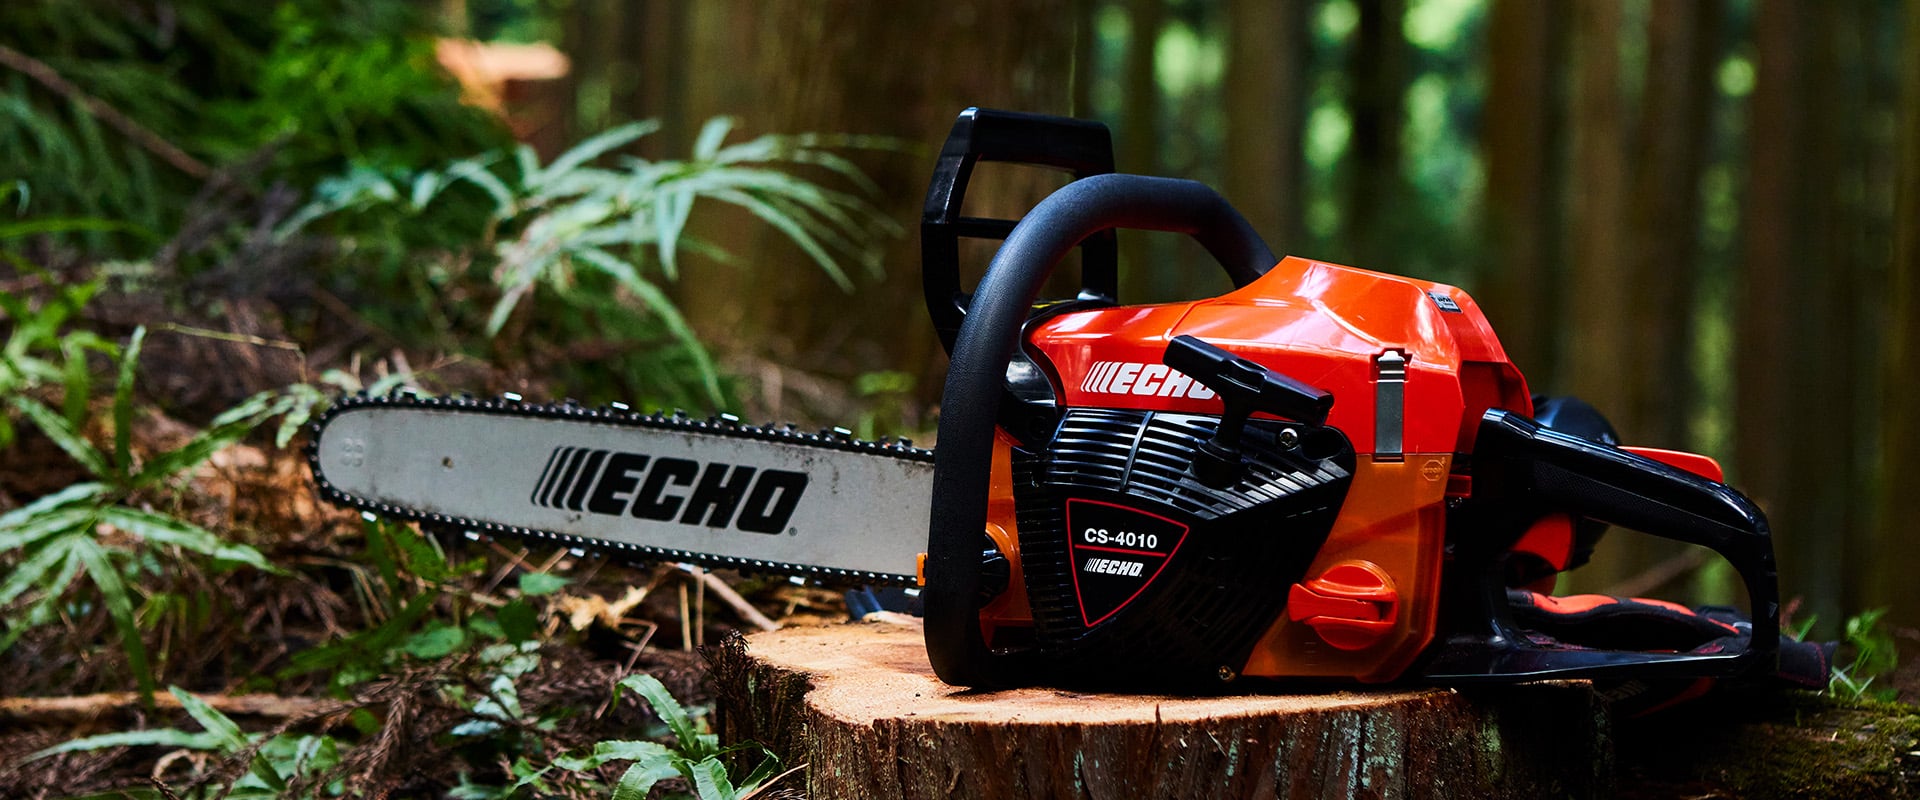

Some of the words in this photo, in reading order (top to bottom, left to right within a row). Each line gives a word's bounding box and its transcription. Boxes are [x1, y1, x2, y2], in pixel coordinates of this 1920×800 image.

[587, 451, 809, 536] ECHO
[1084, 528, 1158, 549] CS-4010
[1096, 559, 1144, 577] ECHO
